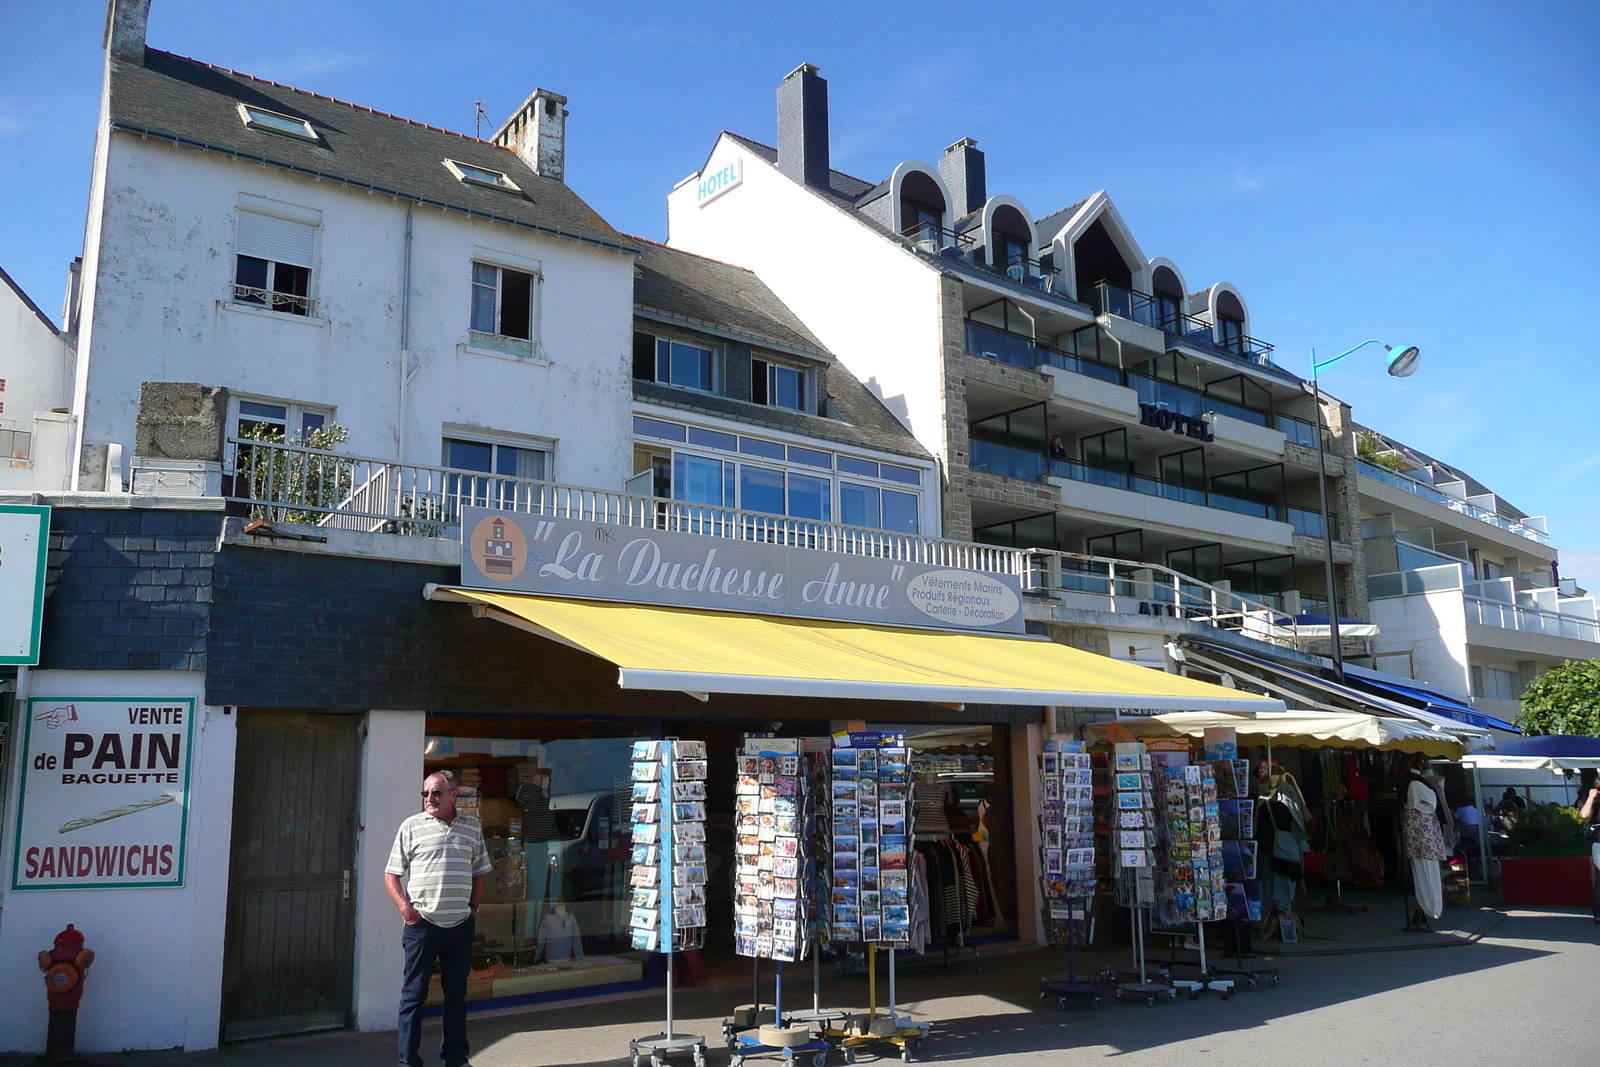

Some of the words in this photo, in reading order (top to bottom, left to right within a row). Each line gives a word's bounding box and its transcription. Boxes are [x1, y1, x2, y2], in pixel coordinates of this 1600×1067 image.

[698, 163, 736, 201] HOTEL
[1140, 403, 1214, 442] HOTEL
[617, 538, 784, 599] Duchesse
[912, 588, 945, 602] Produits
[947, 591, 991, 606] Régionaux
[921, 575, 972, 591] Vêtements
[973, 581, 1003, 595] Marins
[926, 602, 957, 616] Carterie
[964, 606, 1005, 620] Décoration
[128, 707, 183, 726] VENTE
[34, 752, 57, 771] de
[62, 732, 181, 770] PAIN
[61, 773, 179, 785] BAGUETTE
[25, 844, 173, 879] SANDWICHS
